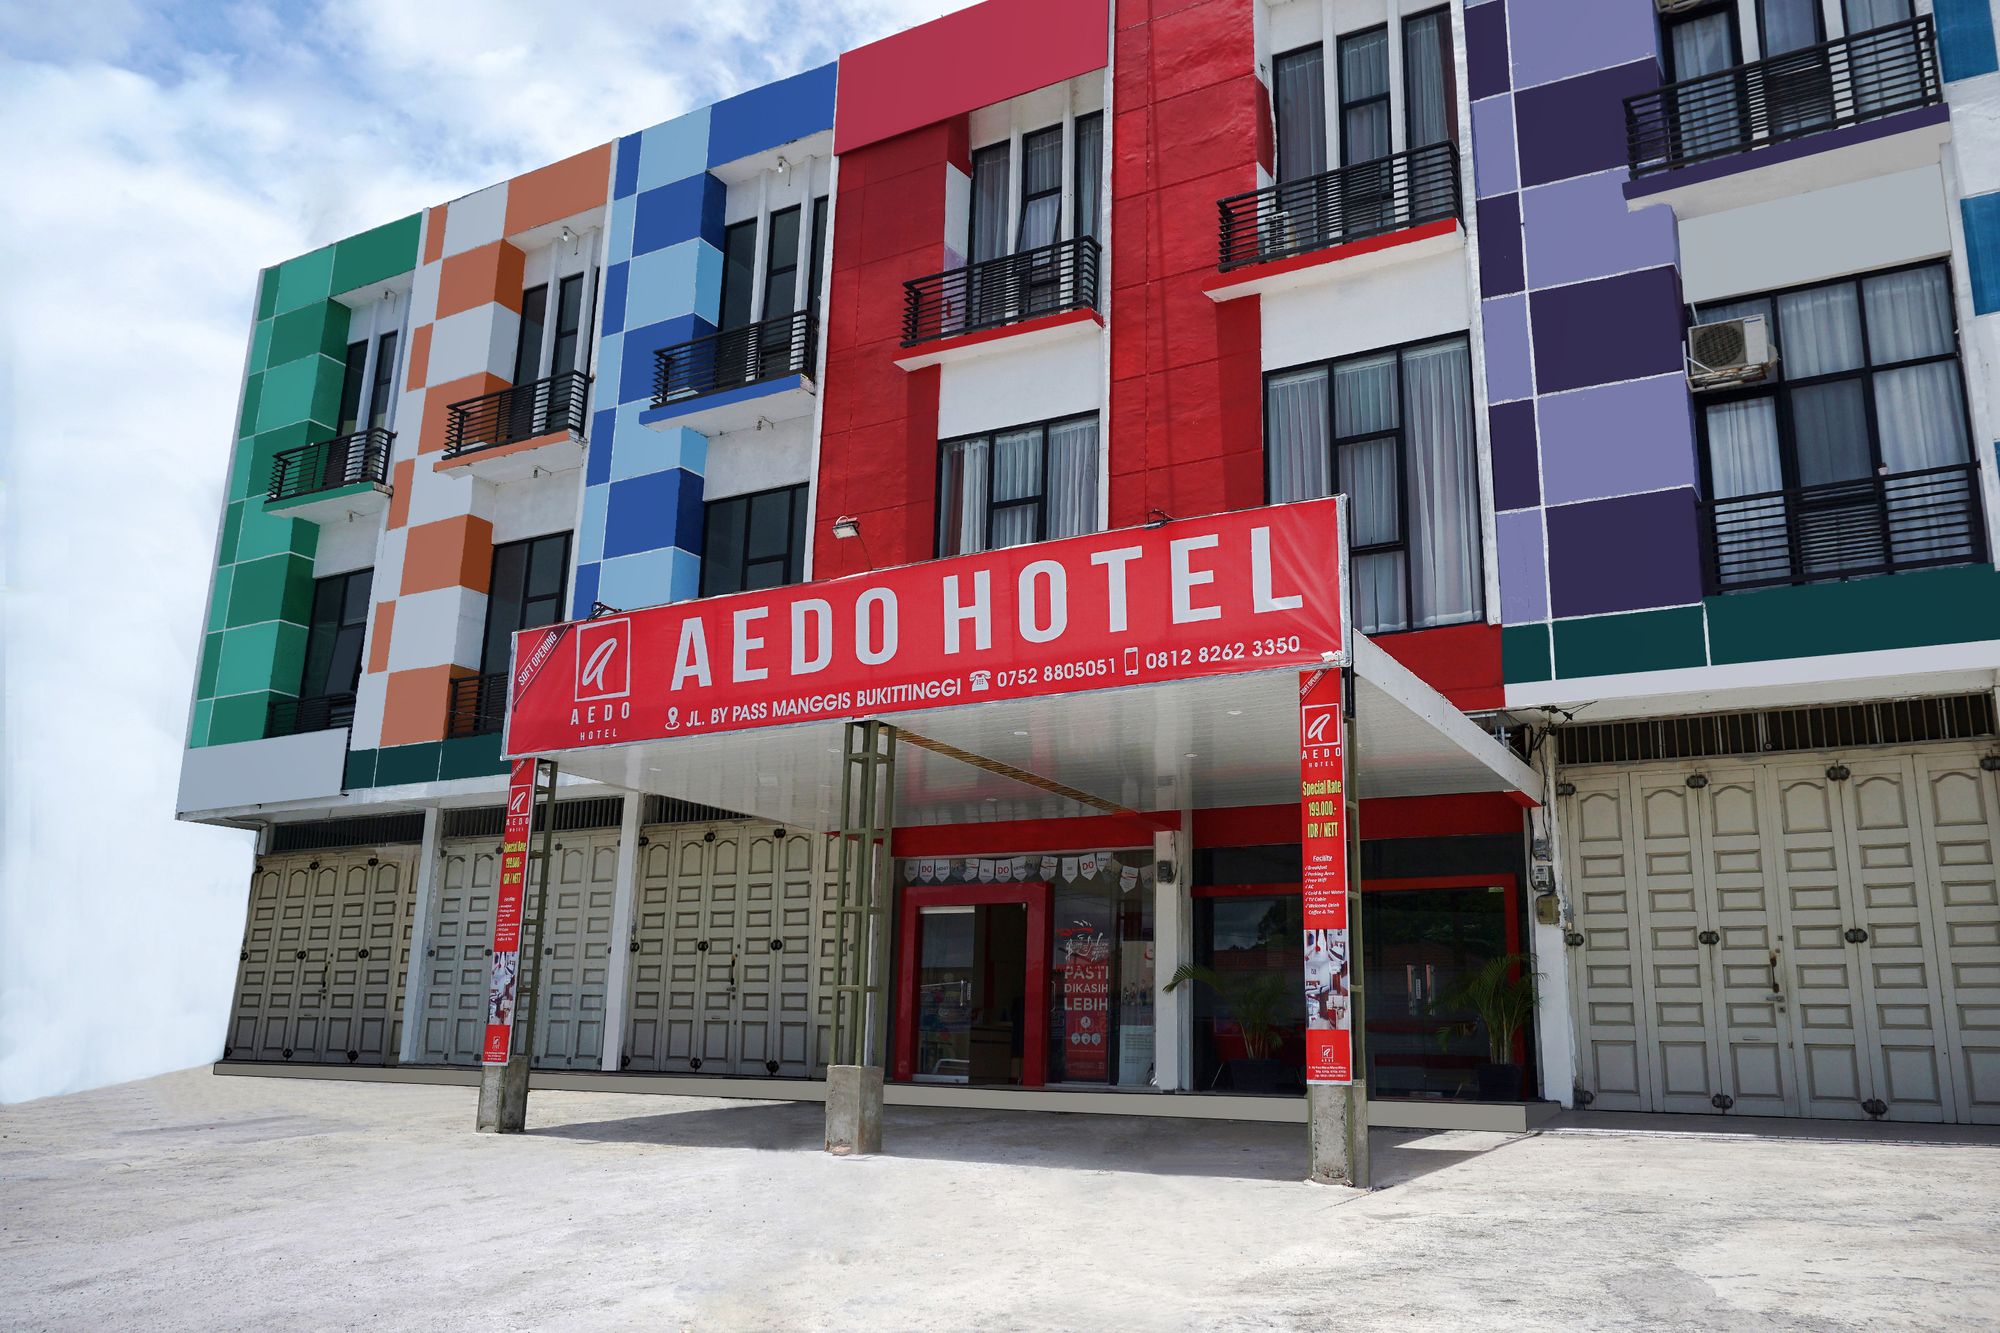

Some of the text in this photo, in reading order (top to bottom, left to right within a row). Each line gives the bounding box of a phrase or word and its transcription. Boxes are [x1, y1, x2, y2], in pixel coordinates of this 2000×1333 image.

[670, 526, 1303, 691] AEDO HOTEL
[517, 631, 558, 687] SOFT OPENING
[685, 635, 1301, 728] JL. BY PASS MANGGIS BUKITTINGGI 0752 8805051 0812 8262 3350
[570, 701, 631, 726] AEDO
[579, 728, 618, 742] HOTEL
[1302, 747, 1342, 761] AEDO
[1303, 779, 1342, 797] Special Rate
[505, 817, 529, 828] AEDO
[1323, 821, 1339, 838] NETT
[1312, 855, 1333, 863] Facility
[1064, 984, 1109, 993] DIKASIH
[1064, 998, 1108, 1011] LEBIH
